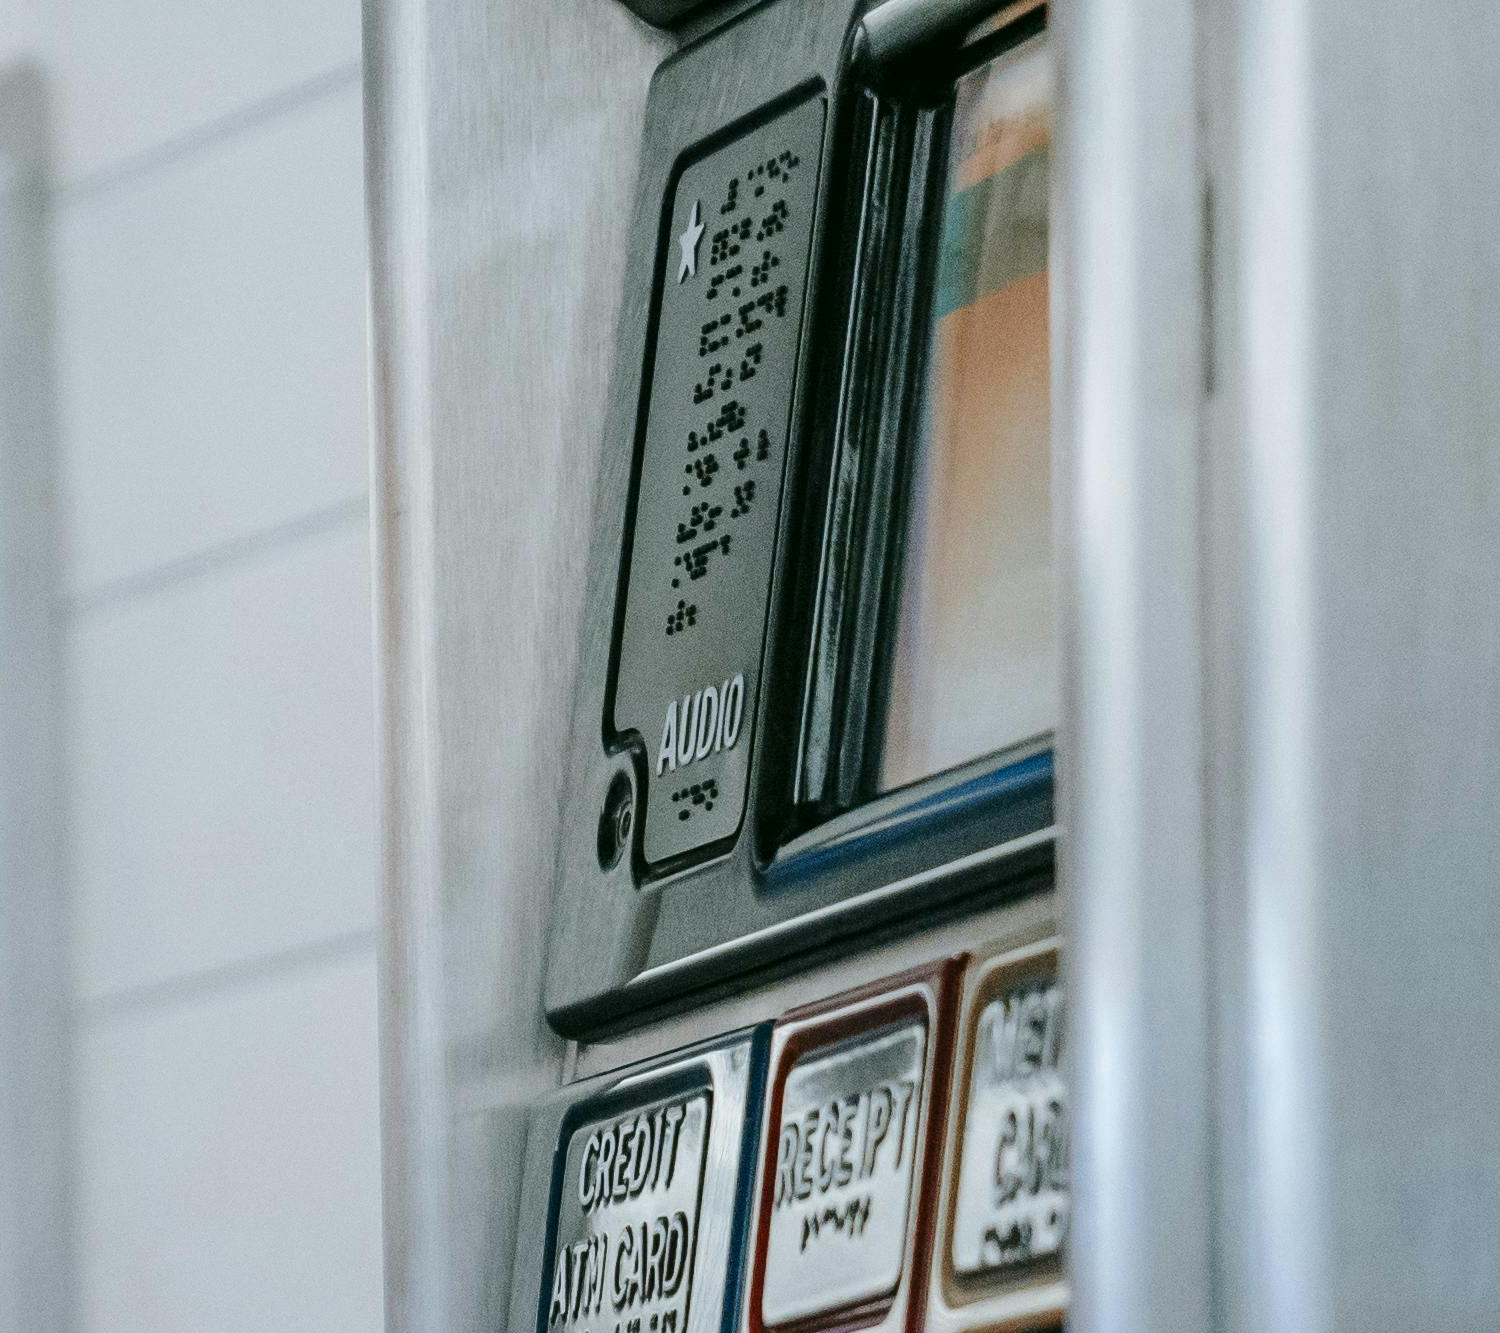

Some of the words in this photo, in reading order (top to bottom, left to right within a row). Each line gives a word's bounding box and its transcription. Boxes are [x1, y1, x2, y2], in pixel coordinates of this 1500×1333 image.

[656, 673, 744, 778] AUDIO
[578, 1102, 686, 1216] CREDIT
[776, 1081, 916, 1211] RECEIPT
[549, 1230, 609, 1328] ATM
[612, 1211, 690, 1313] CARD
